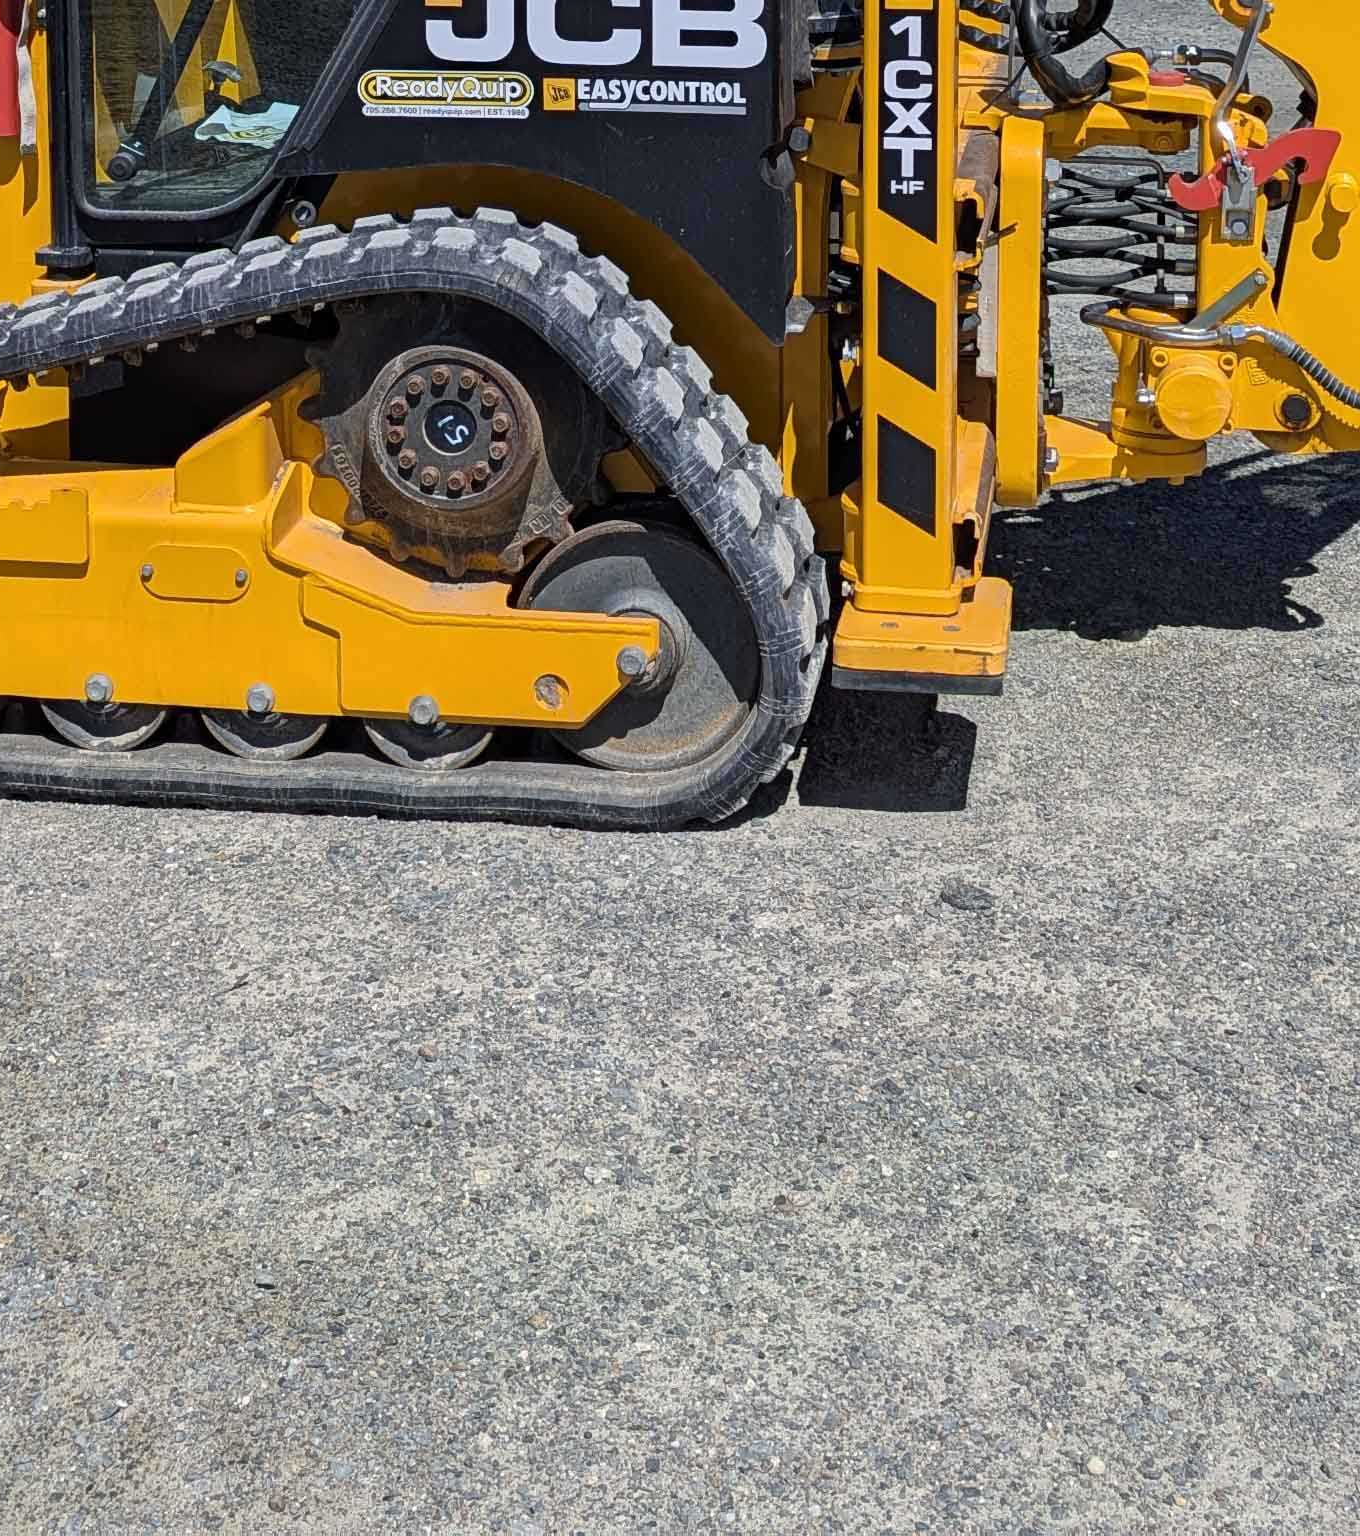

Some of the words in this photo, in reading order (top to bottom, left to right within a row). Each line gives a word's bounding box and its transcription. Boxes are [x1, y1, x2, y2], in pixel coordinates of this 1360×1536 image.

[375, 75, 523, 104] ReadyQuip
[883, 16, 933, 178] 1CXT
[890, 180, 924, 194] HF
